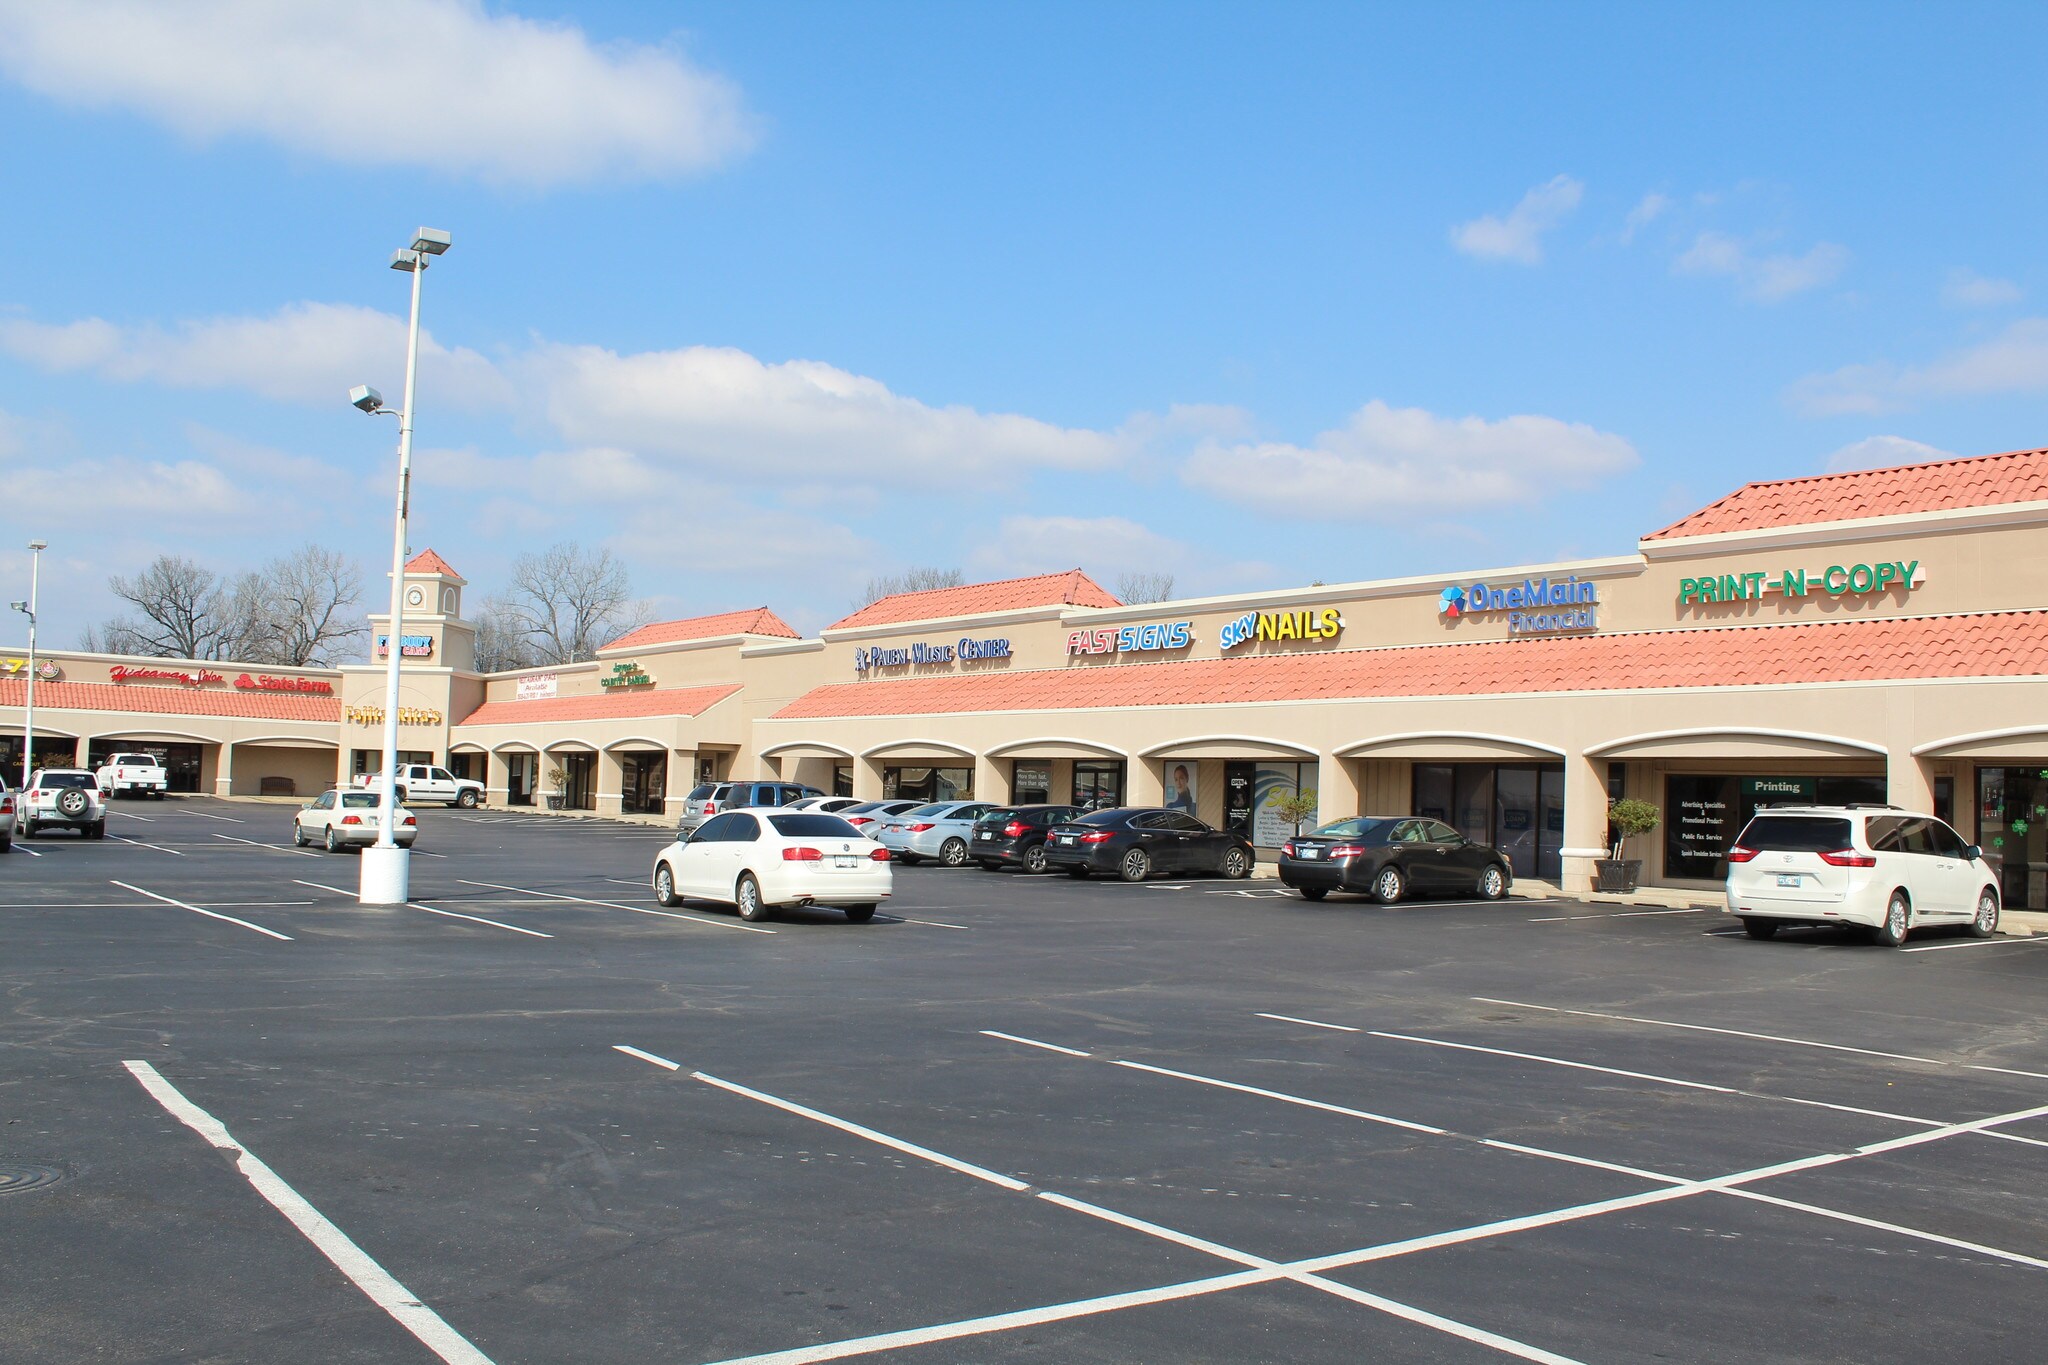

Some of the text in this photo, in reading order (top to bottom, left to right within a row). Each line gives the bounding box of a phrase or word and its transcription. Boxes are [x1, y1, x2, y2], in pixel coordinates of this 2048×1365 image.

[1468, 576, 1596, 611] OneMain
[1680, 561, 1919, 604] PRINT-N-COPY
[1220, 608, 1341, 649] SKY NAILS
[1509, 606, 1596, 632] Financial
[911, 642, 952, 663] MUSIC
[958, 637, 1010, 660] CENTER
[1065, 622, 1192, 655] FASTSIGNS
[109, 665, 223, 686] Hideaway Salon
[1755, 781, 1800, 793] Printing
[1681, 801, 1726, 809] Advertising Specialties
[1705, 833, 1723, 841] Service
